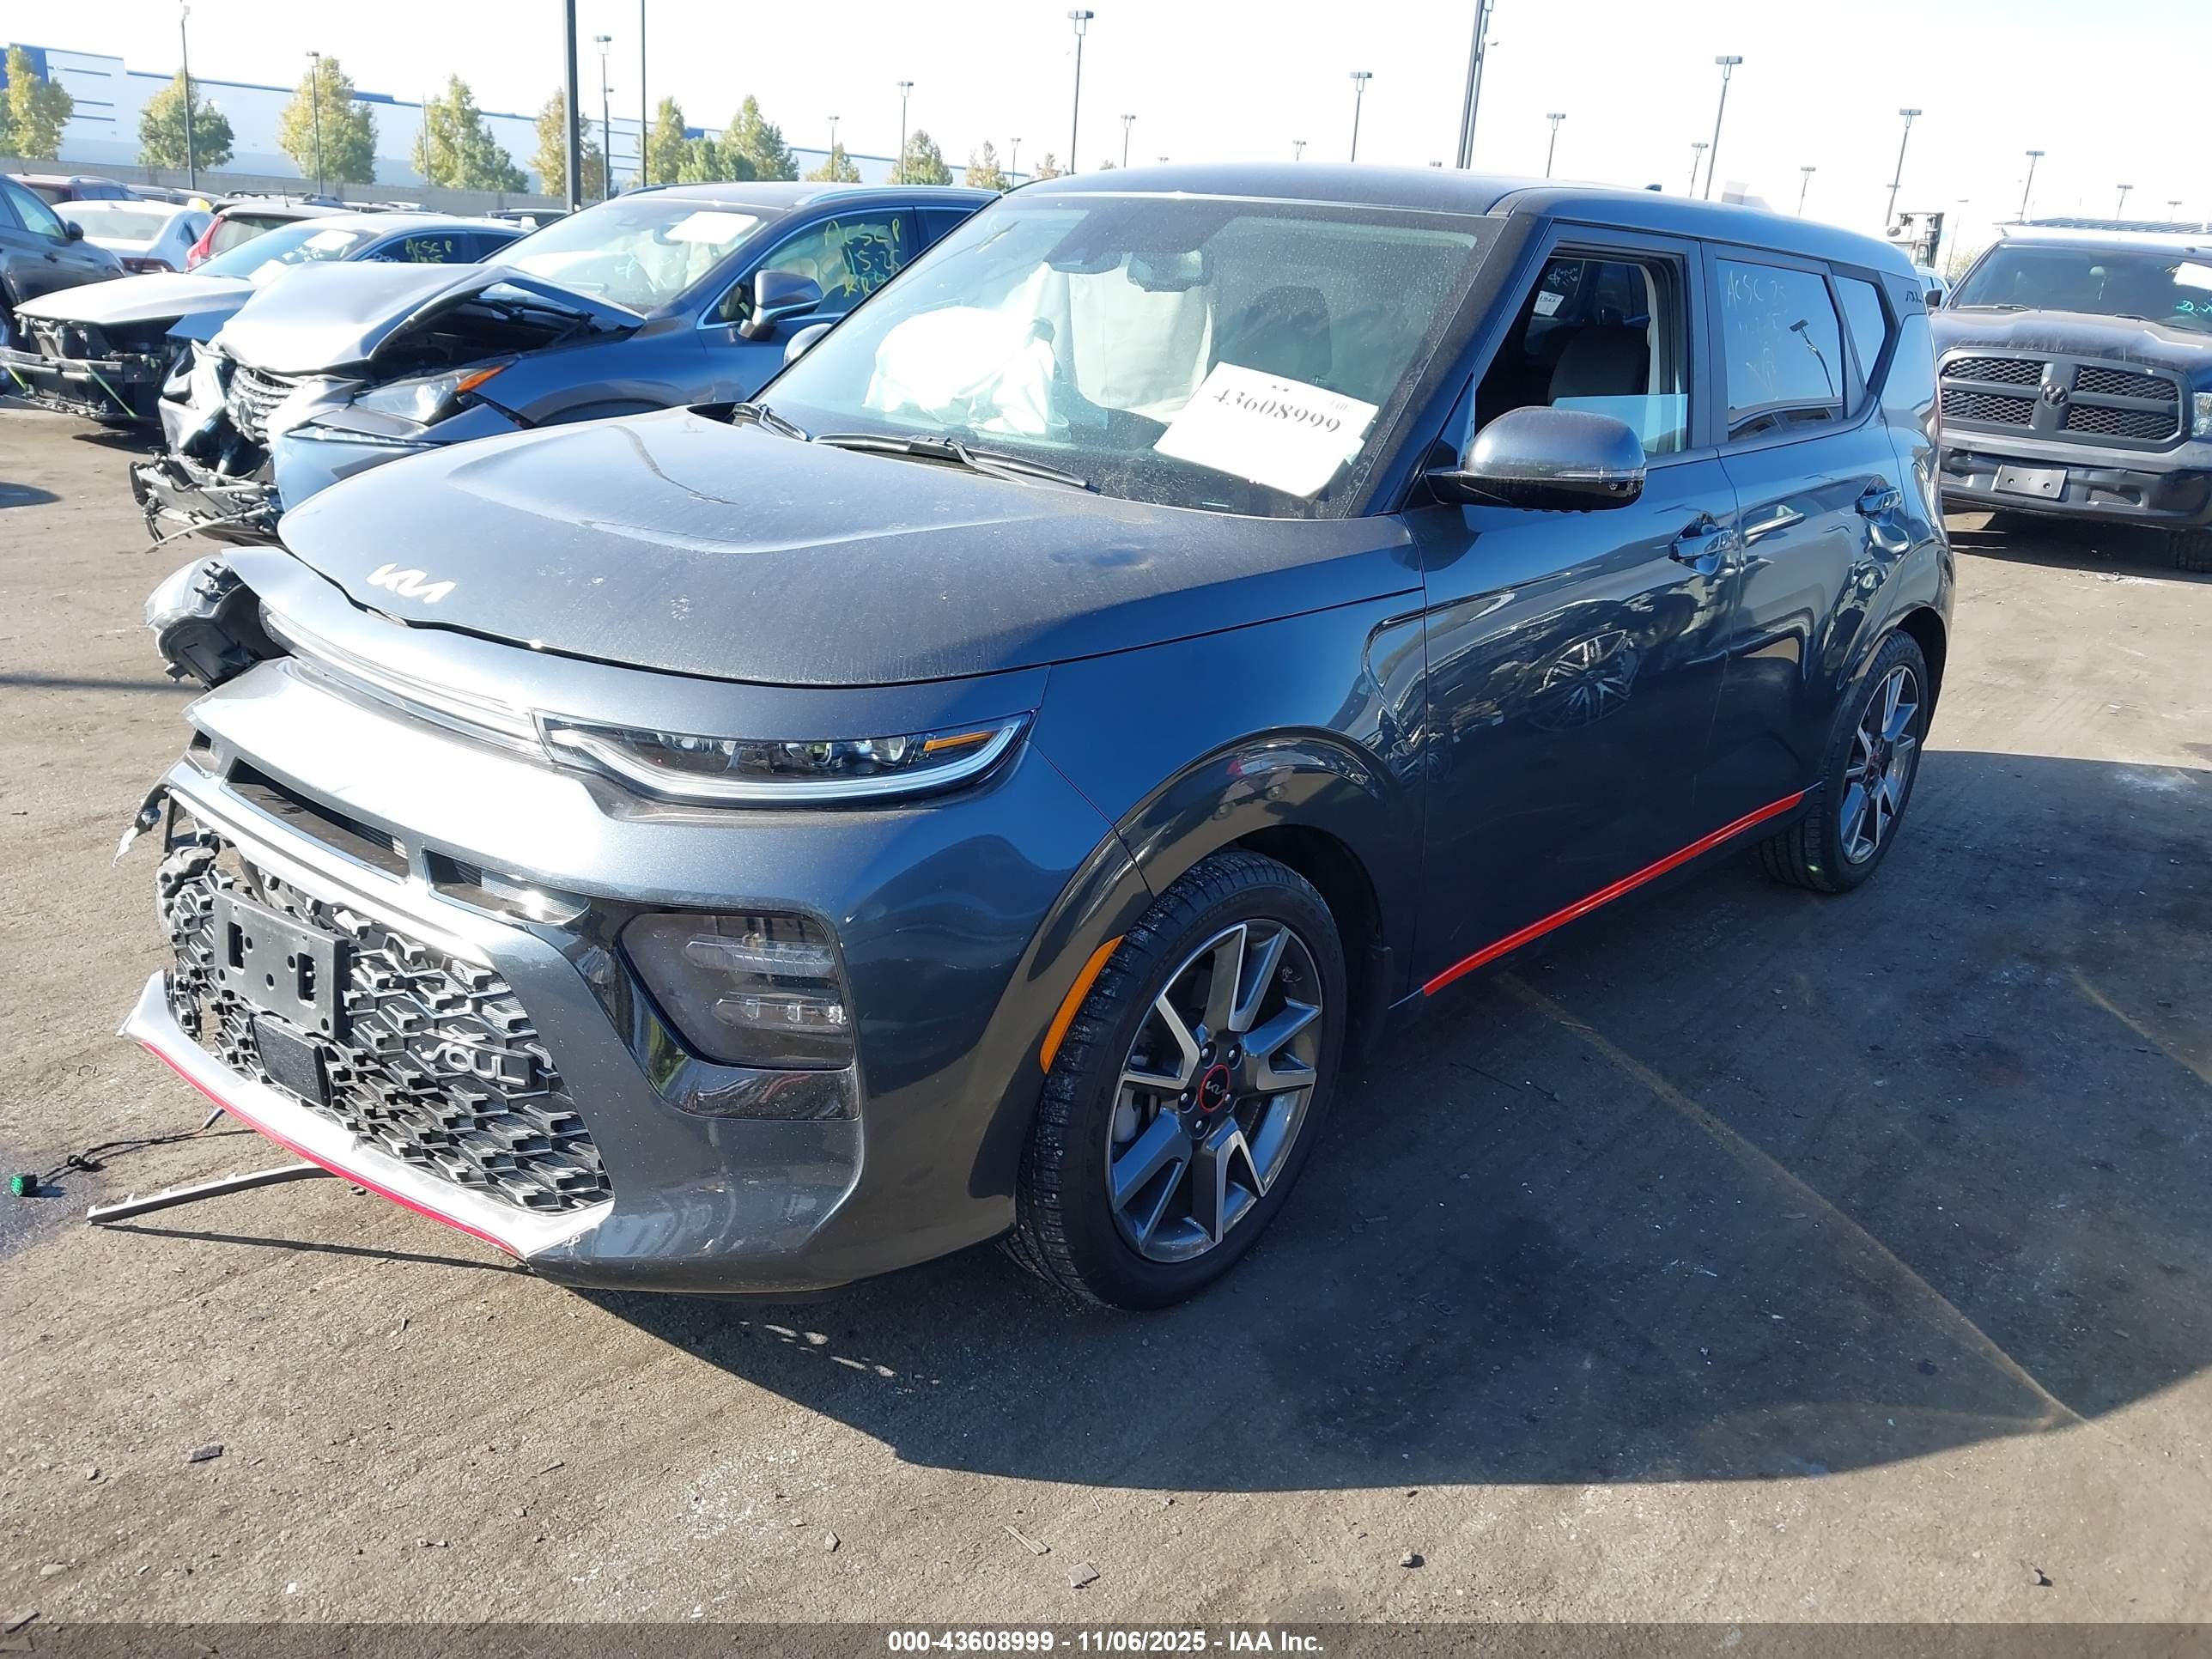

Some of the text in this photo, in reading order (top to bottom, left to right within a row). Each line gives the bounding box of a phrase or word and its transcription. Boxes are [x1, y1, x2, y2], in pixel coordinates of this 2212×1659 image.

[1213, 388, 1341, 433] 43608999
[365, 562, 457, 604] KIA
[420, 1042, 526, 1086] SOUL
